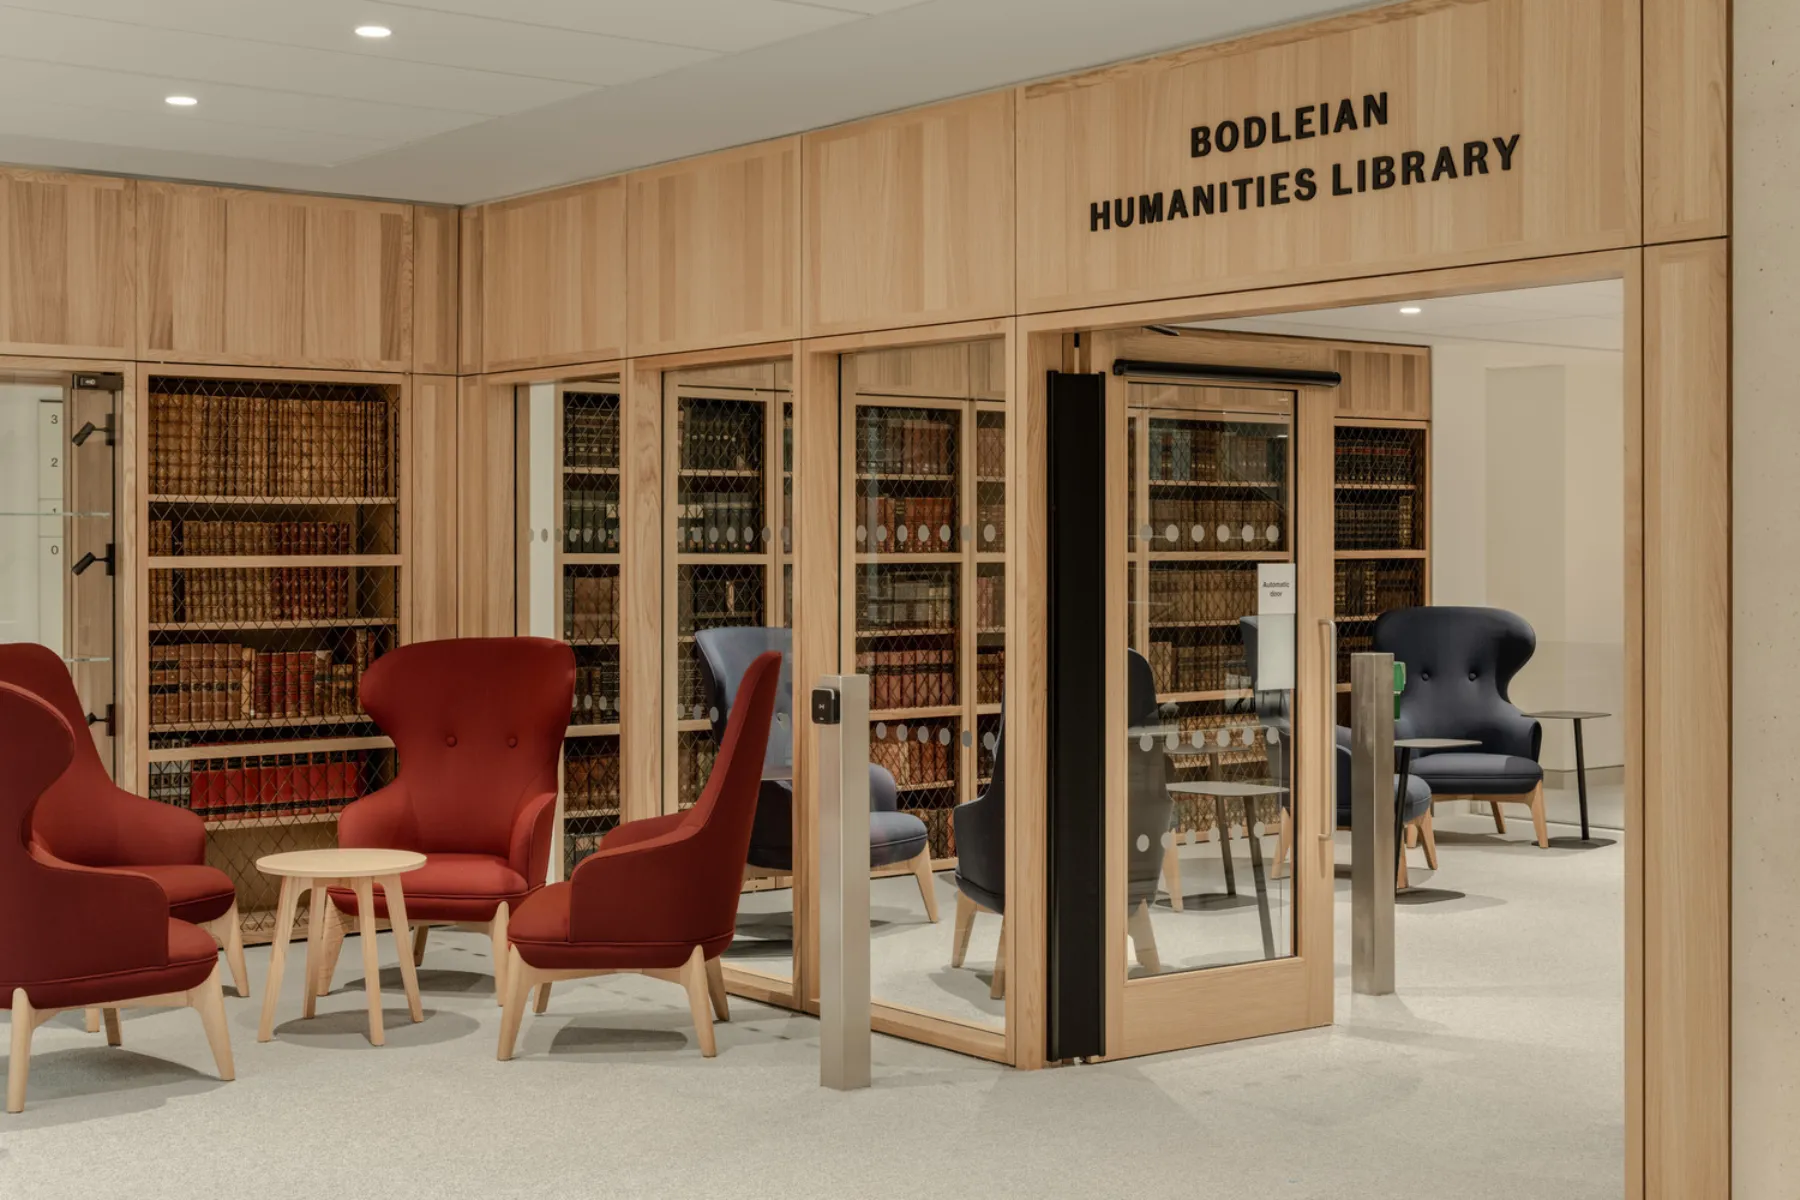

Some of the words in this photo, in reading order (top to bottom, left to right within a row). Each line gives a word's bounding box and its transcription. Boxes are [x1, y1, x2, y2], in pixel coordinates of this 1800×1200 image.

[1190, 91, 1388, 158] BODLEIAN
[1090, 167, 1318, 232] HUMANITIES
[1332, 134, 1521, 197] LIBRARY
[51, 414, 59, 425] 3
[51, 457, 59, 468] 2
[1262, 581, 1290, 589] Automatic
